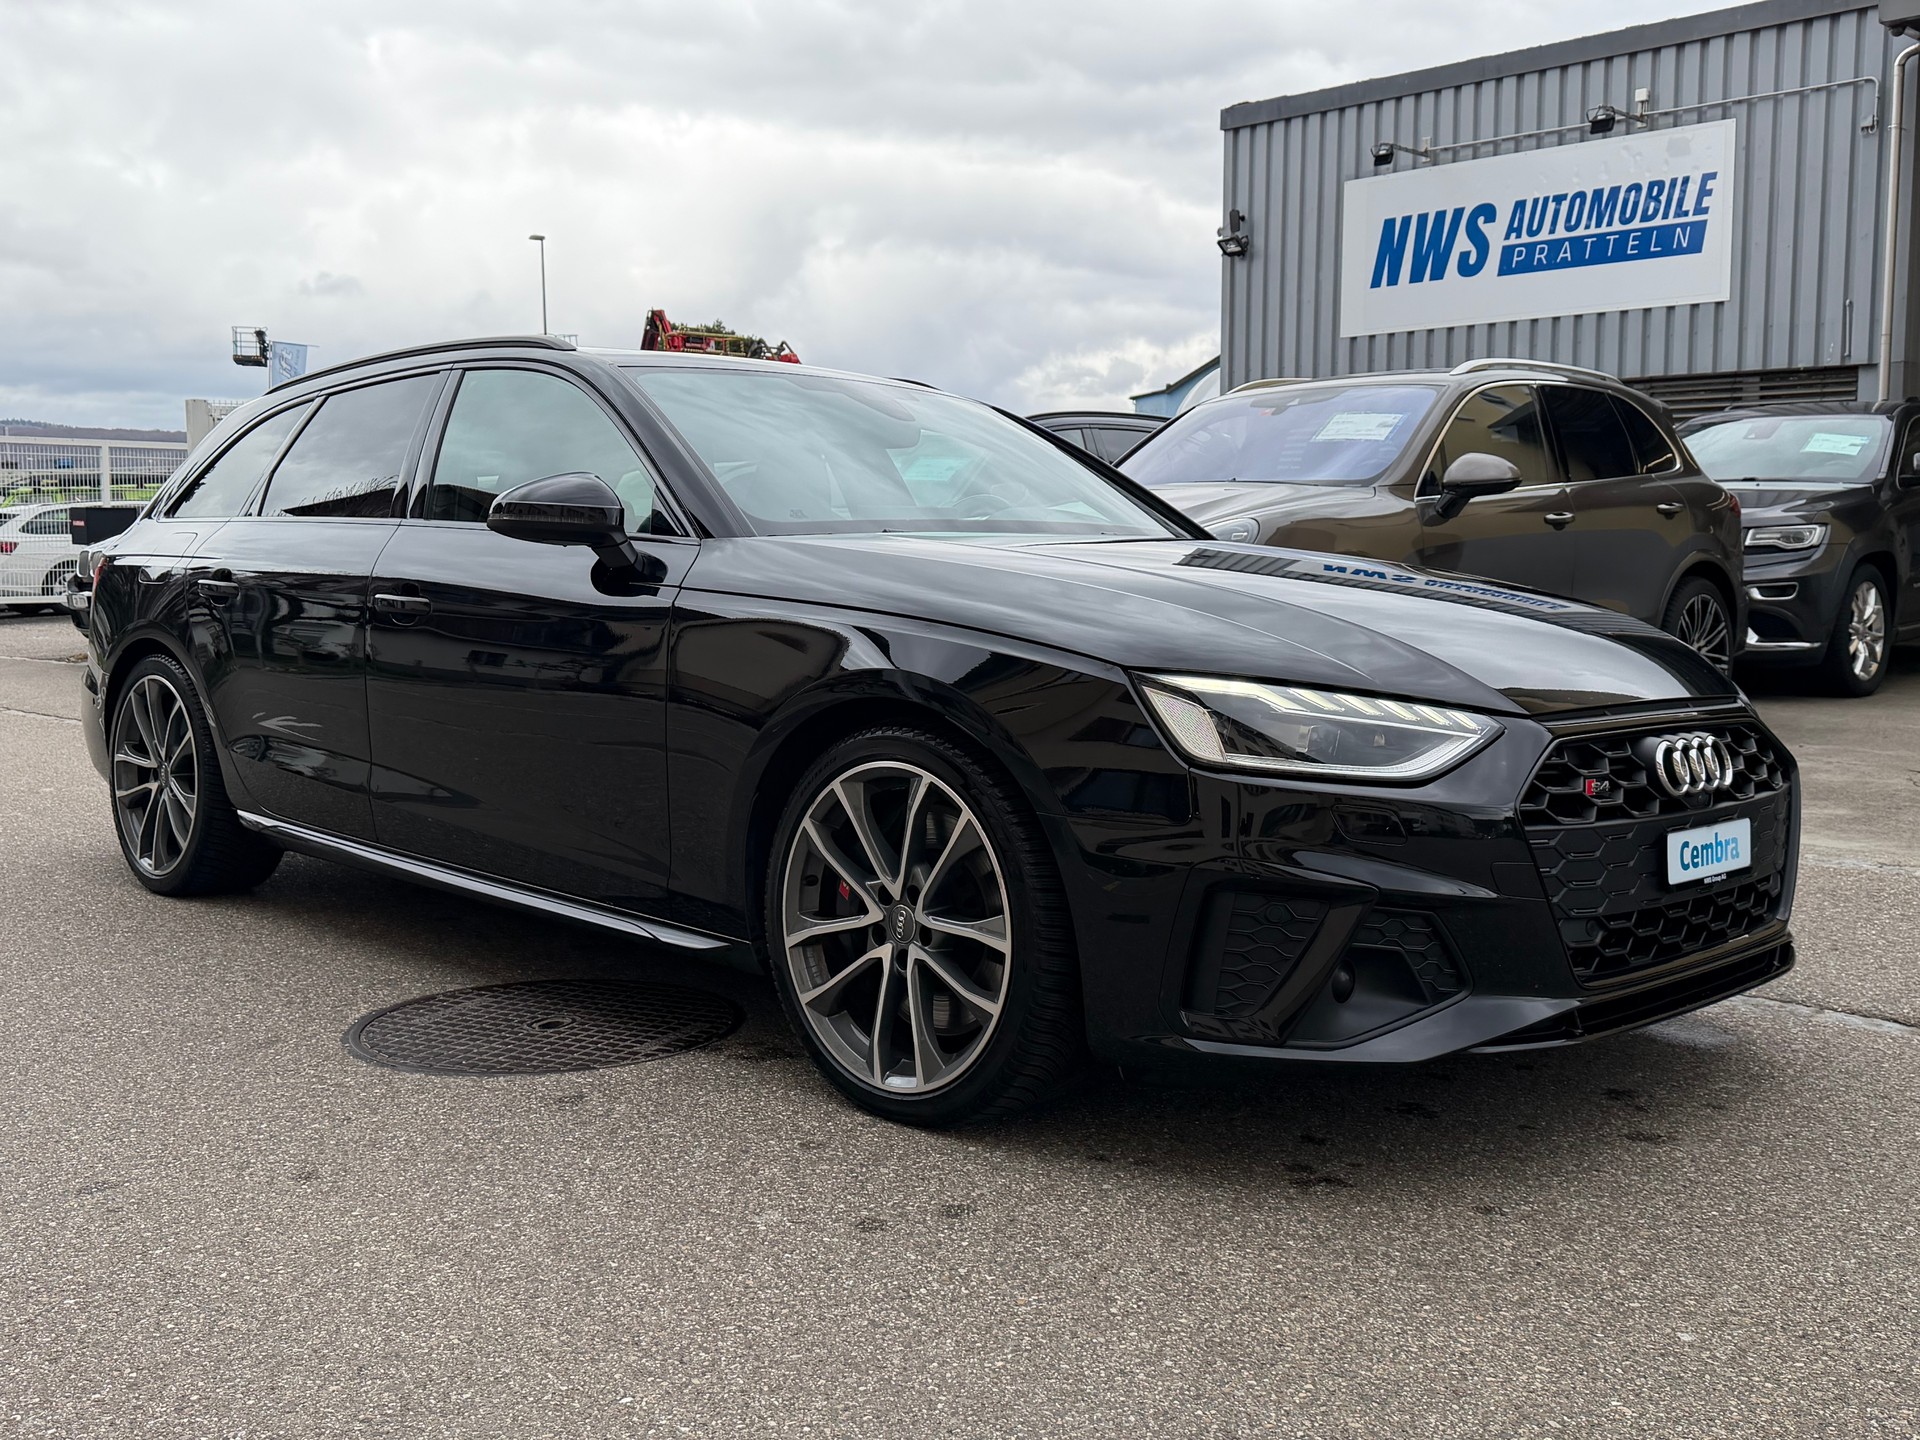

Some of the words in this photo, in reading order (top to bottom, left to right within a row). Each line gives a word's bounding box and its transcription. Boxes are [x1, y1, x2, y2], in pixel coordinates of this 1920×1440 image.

[1370, 202, 1498, 289] NWS
[1503, 171, 1718, 241] AUTOMOBILE
[1511, 226, 1692, 269] PRATTELN
[1679, 832, 1740, 871] Cembra
